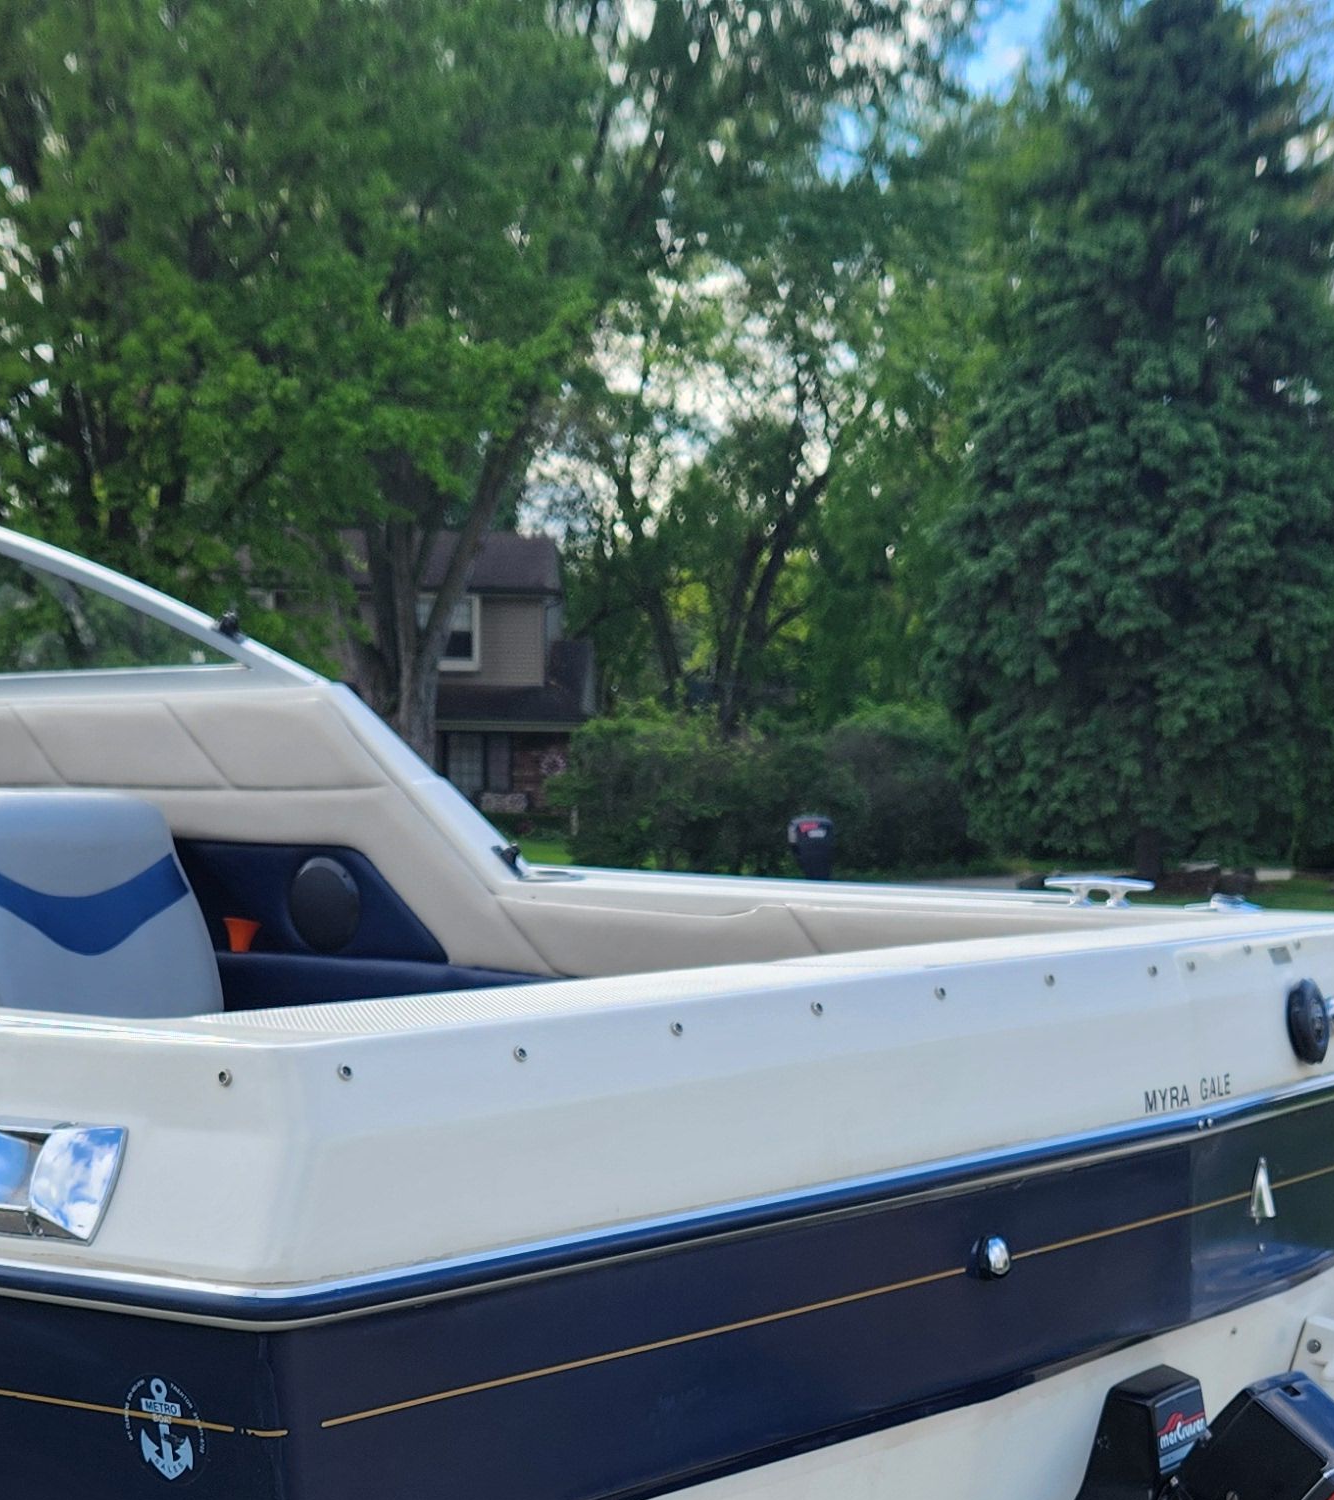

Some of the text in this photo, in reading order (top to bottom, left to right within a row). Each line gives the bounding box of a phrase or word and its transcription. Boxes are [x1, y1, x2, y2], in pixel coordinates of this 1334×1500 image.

[1144, 1073, 1231, 1113] MYRA GALE
[144, 1400, 178, 1416] METRO
[154, 1458, 185, 1473] SALES
